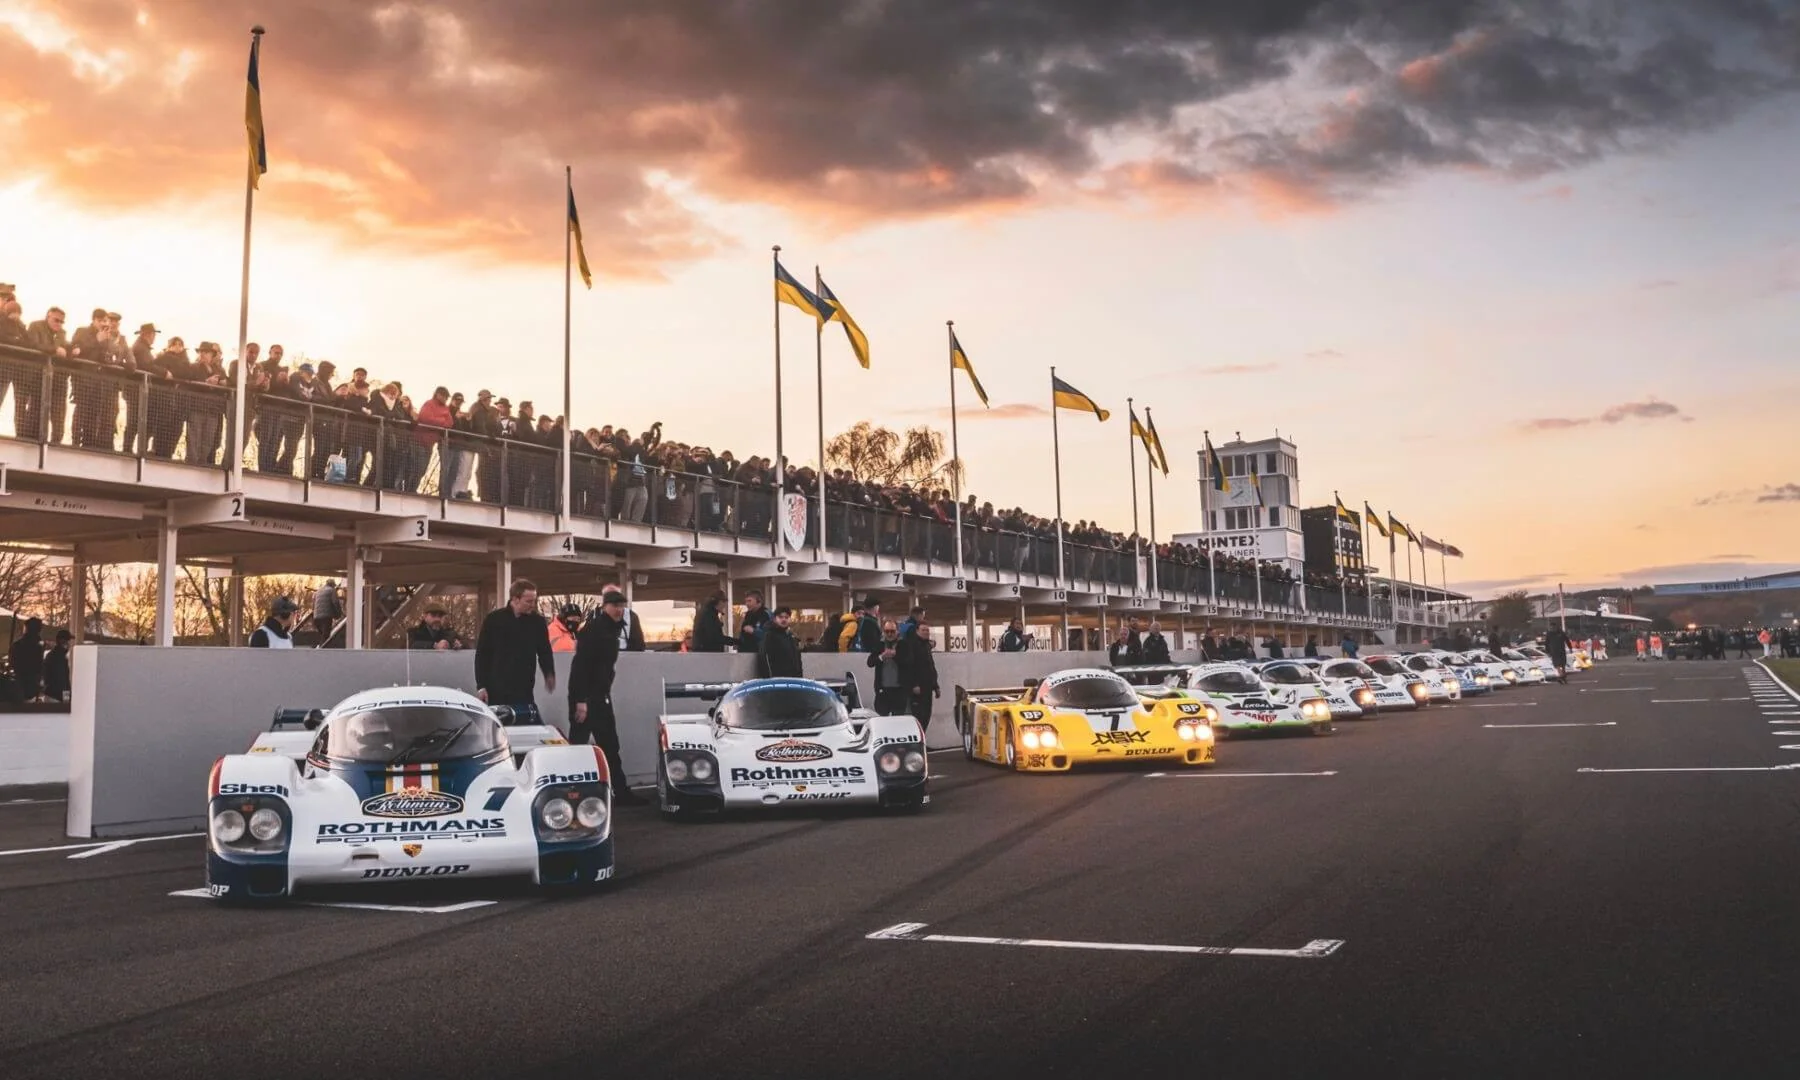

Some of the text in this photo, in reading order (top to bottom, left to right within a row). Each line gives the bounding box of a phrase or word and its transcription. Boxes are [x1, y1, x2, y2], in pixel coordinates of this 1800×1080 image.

[231, 498, 241, 516] 2
[416, 521, 424, 536] 3
[562, 537, 571, 551] 4
[1197, 535, 1260, 549] MINTEX
[680, 550, 687, 563] 5
[777, 561, 785, 573] 6
[893, 573, 900, 584] 7
[957, 580, 964, 590] 8
[1012, 586, 1019, 595] 9
[1054, 591, 1065, 600] 10
[1097, 595, 1107, 604] 11
[1132, 599, 1142, 607] 12
[337, 700, 484, 715] PORSCHE
[1181, 704, 1199, 713] BP
[1023, 711, 1042, 719] BP
[671, 741, 717, 753] Shell
[873, 735, 918, 749] Shell
[767, 746, 823, 758] Rothmans
[1125, 747, 1175, 756] DUNLOP
[731, 765, 864, 781] Rothmans
[535, 771, 598, 789] Shell
[220, 783, 289, 798] Shell
[786, 792, 851, 800] DUNLOP
[374, 796, 453, 812] Rothmans
[483, 787, 516, 812] 1
[317, 818, 505, 836] ROTHMANS
[315, 832, 507, 845] PORSCHE
[360, 864, 471, 879] DUNLOP
